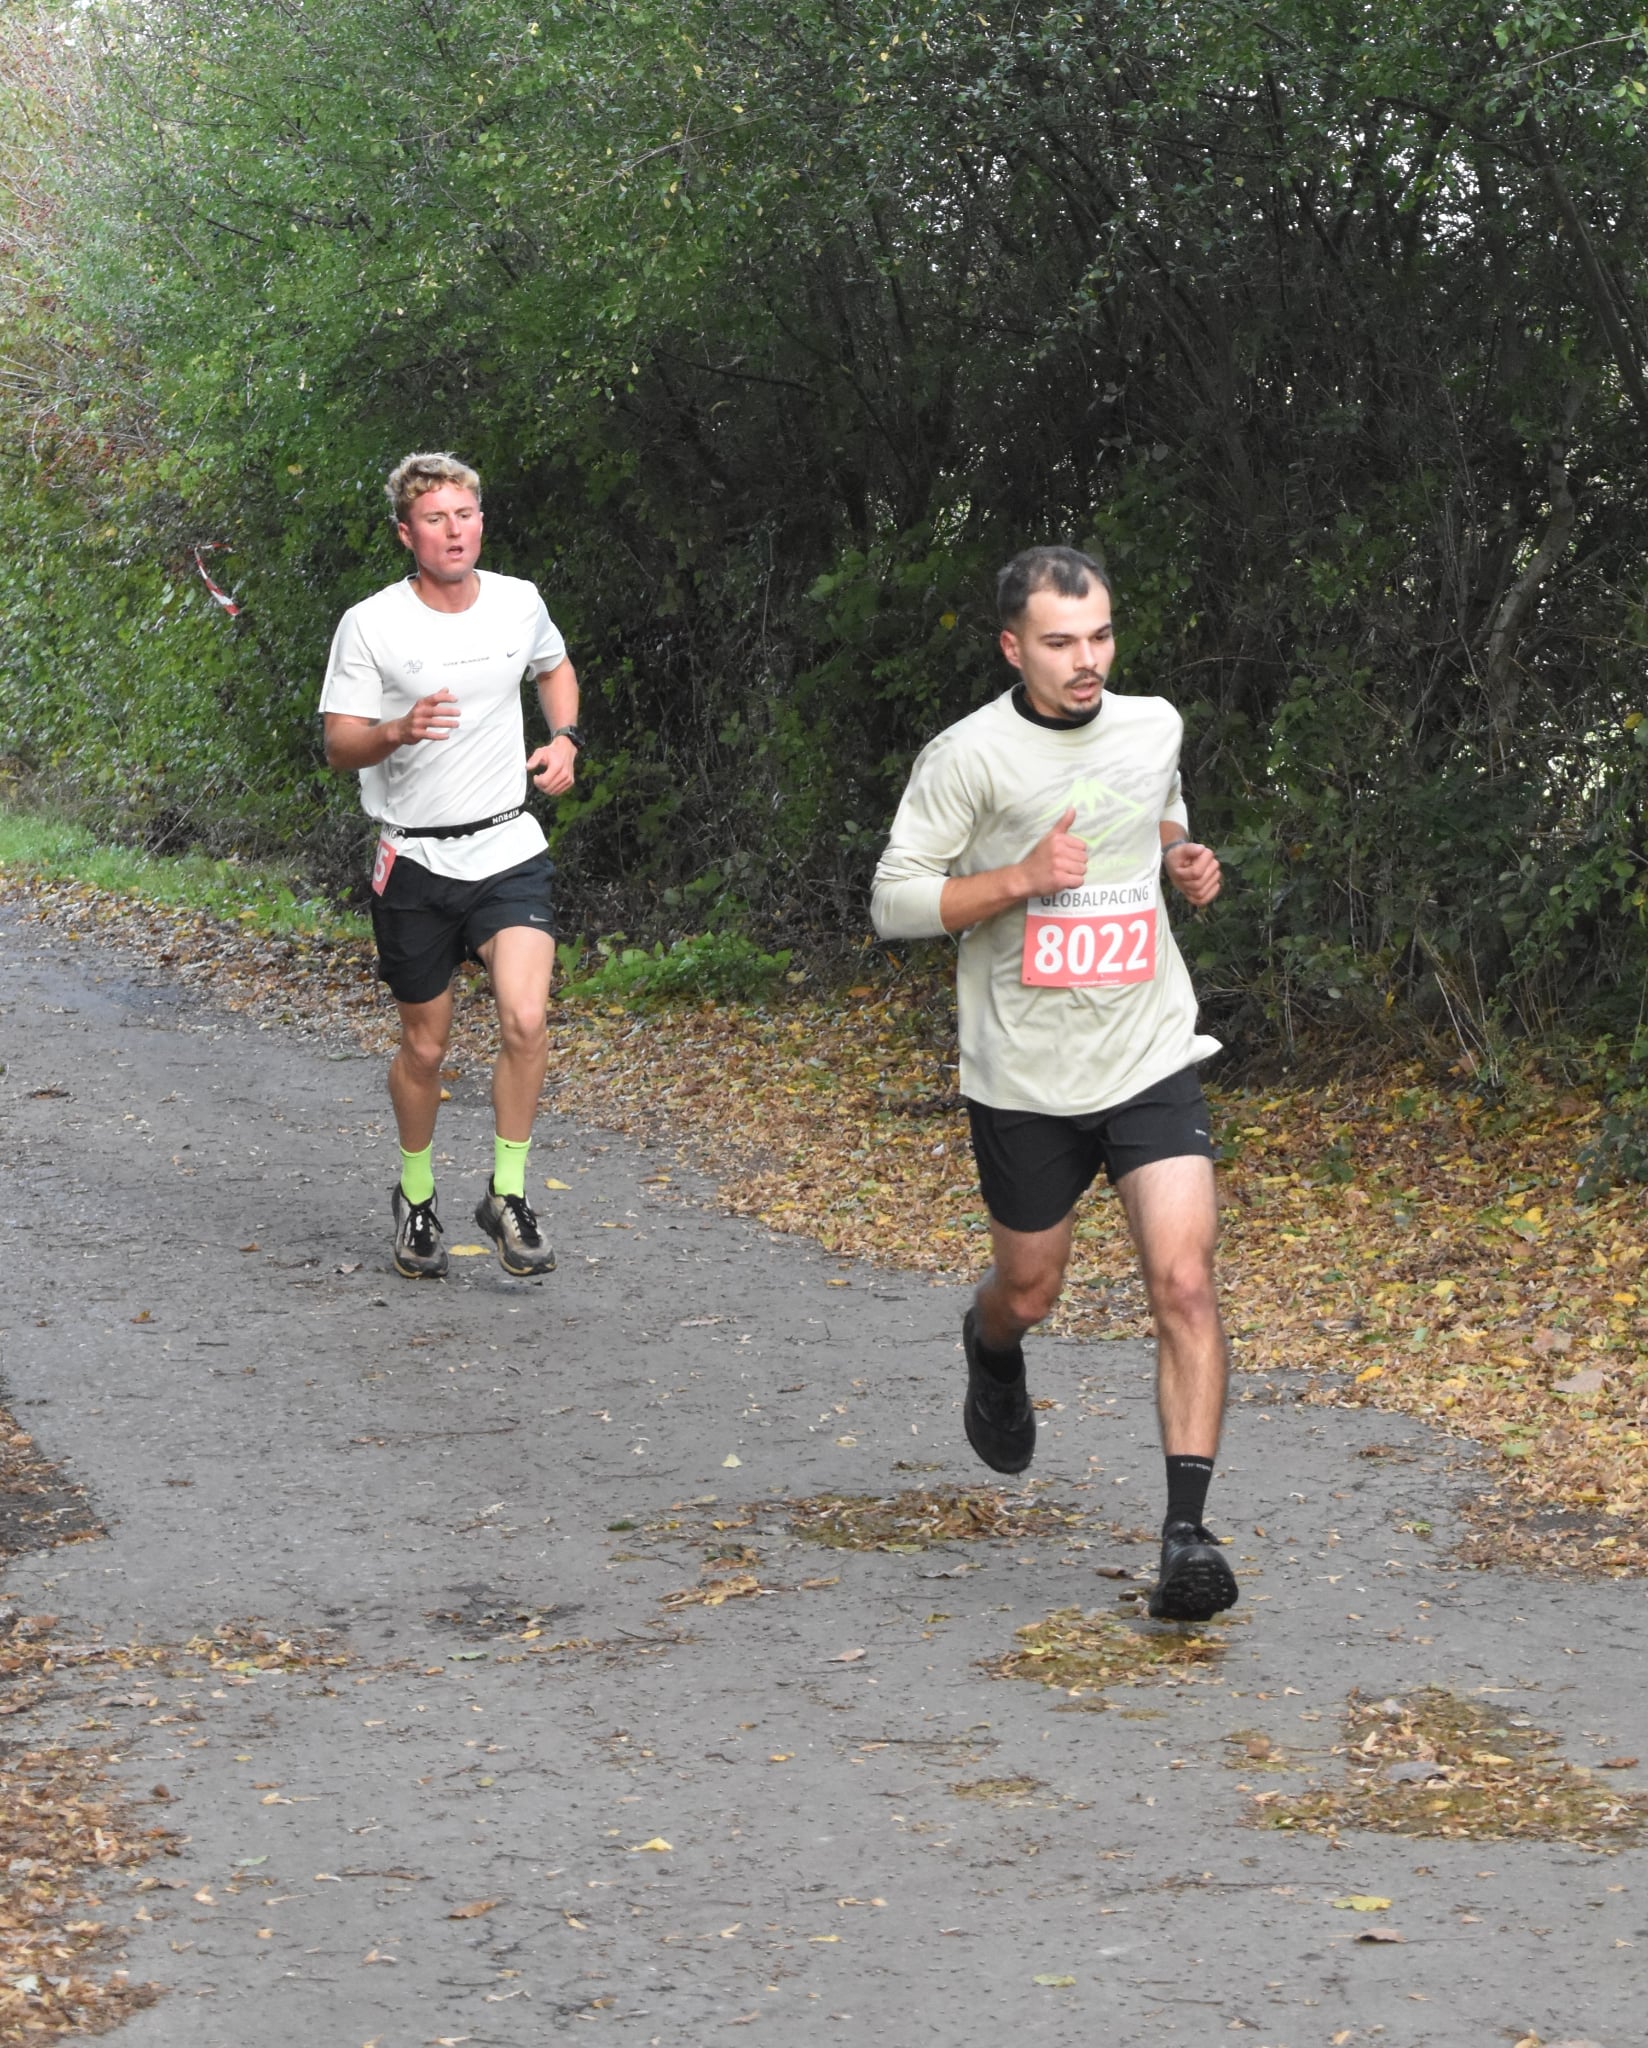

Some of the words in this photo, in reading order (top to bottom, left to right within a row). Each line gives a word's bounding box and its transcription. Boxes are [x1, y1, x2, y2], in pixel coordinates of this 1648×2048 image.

[492, 808, 520, 825] KIPRUN
[1040, 885, 1150, 908] GLOBALPACING
[1034, 919, 1149, 976] 8022
